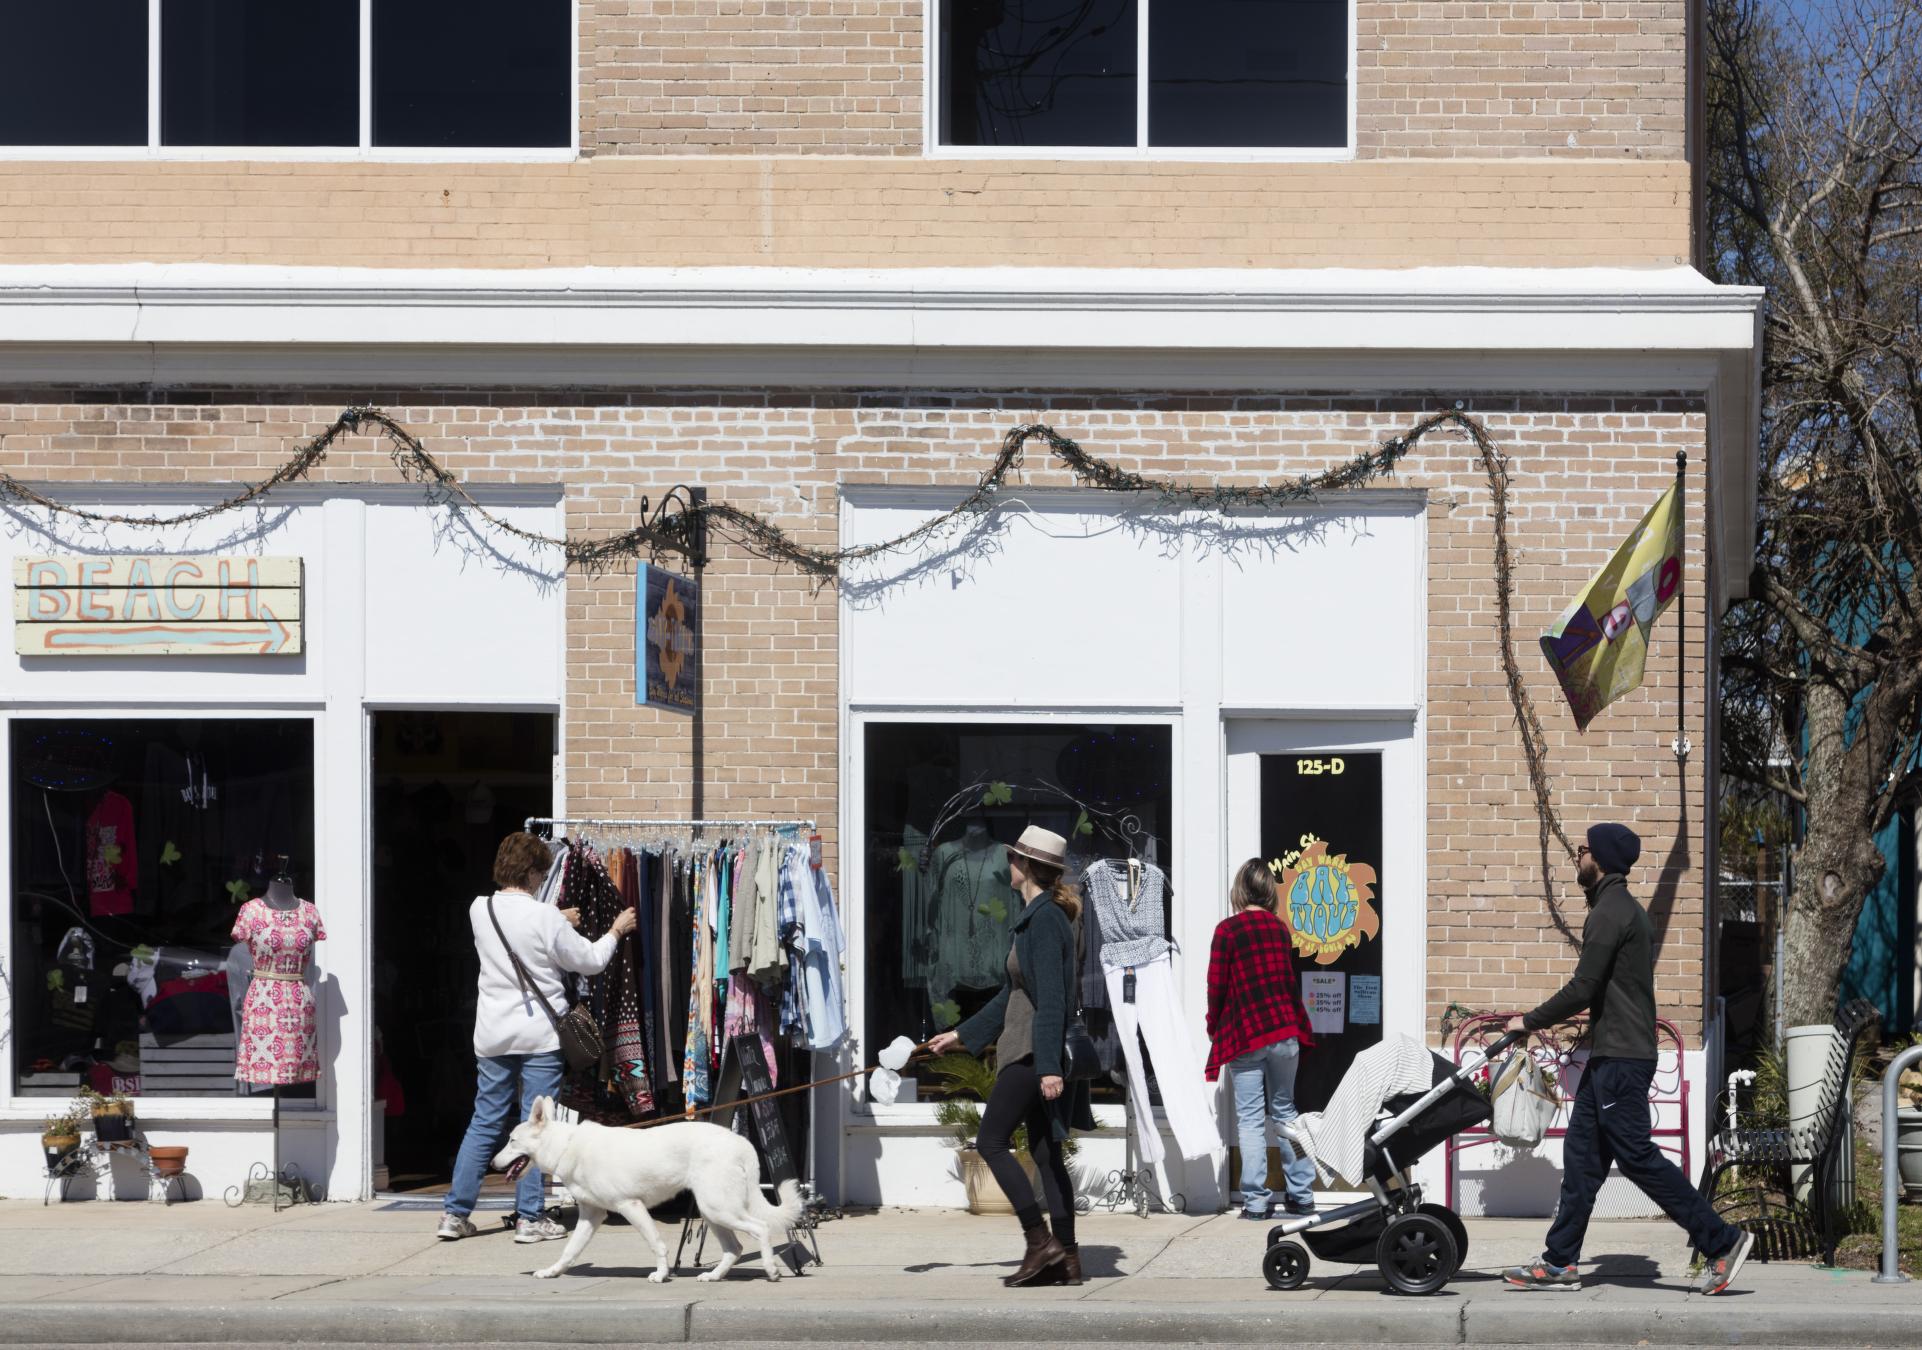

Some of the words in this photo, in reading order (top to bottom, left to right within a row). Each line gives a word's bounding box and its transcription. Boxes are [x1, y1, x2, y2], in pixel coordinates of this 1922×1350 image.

[27, 559, 259, 621] BEACH
[1297, 758, 1345, 774] 125-D
[1268, 850, 1300, 876] Main
[1300, 832, 1320, 850] St.
[1290, 901, 1358, 944] TIQUE
